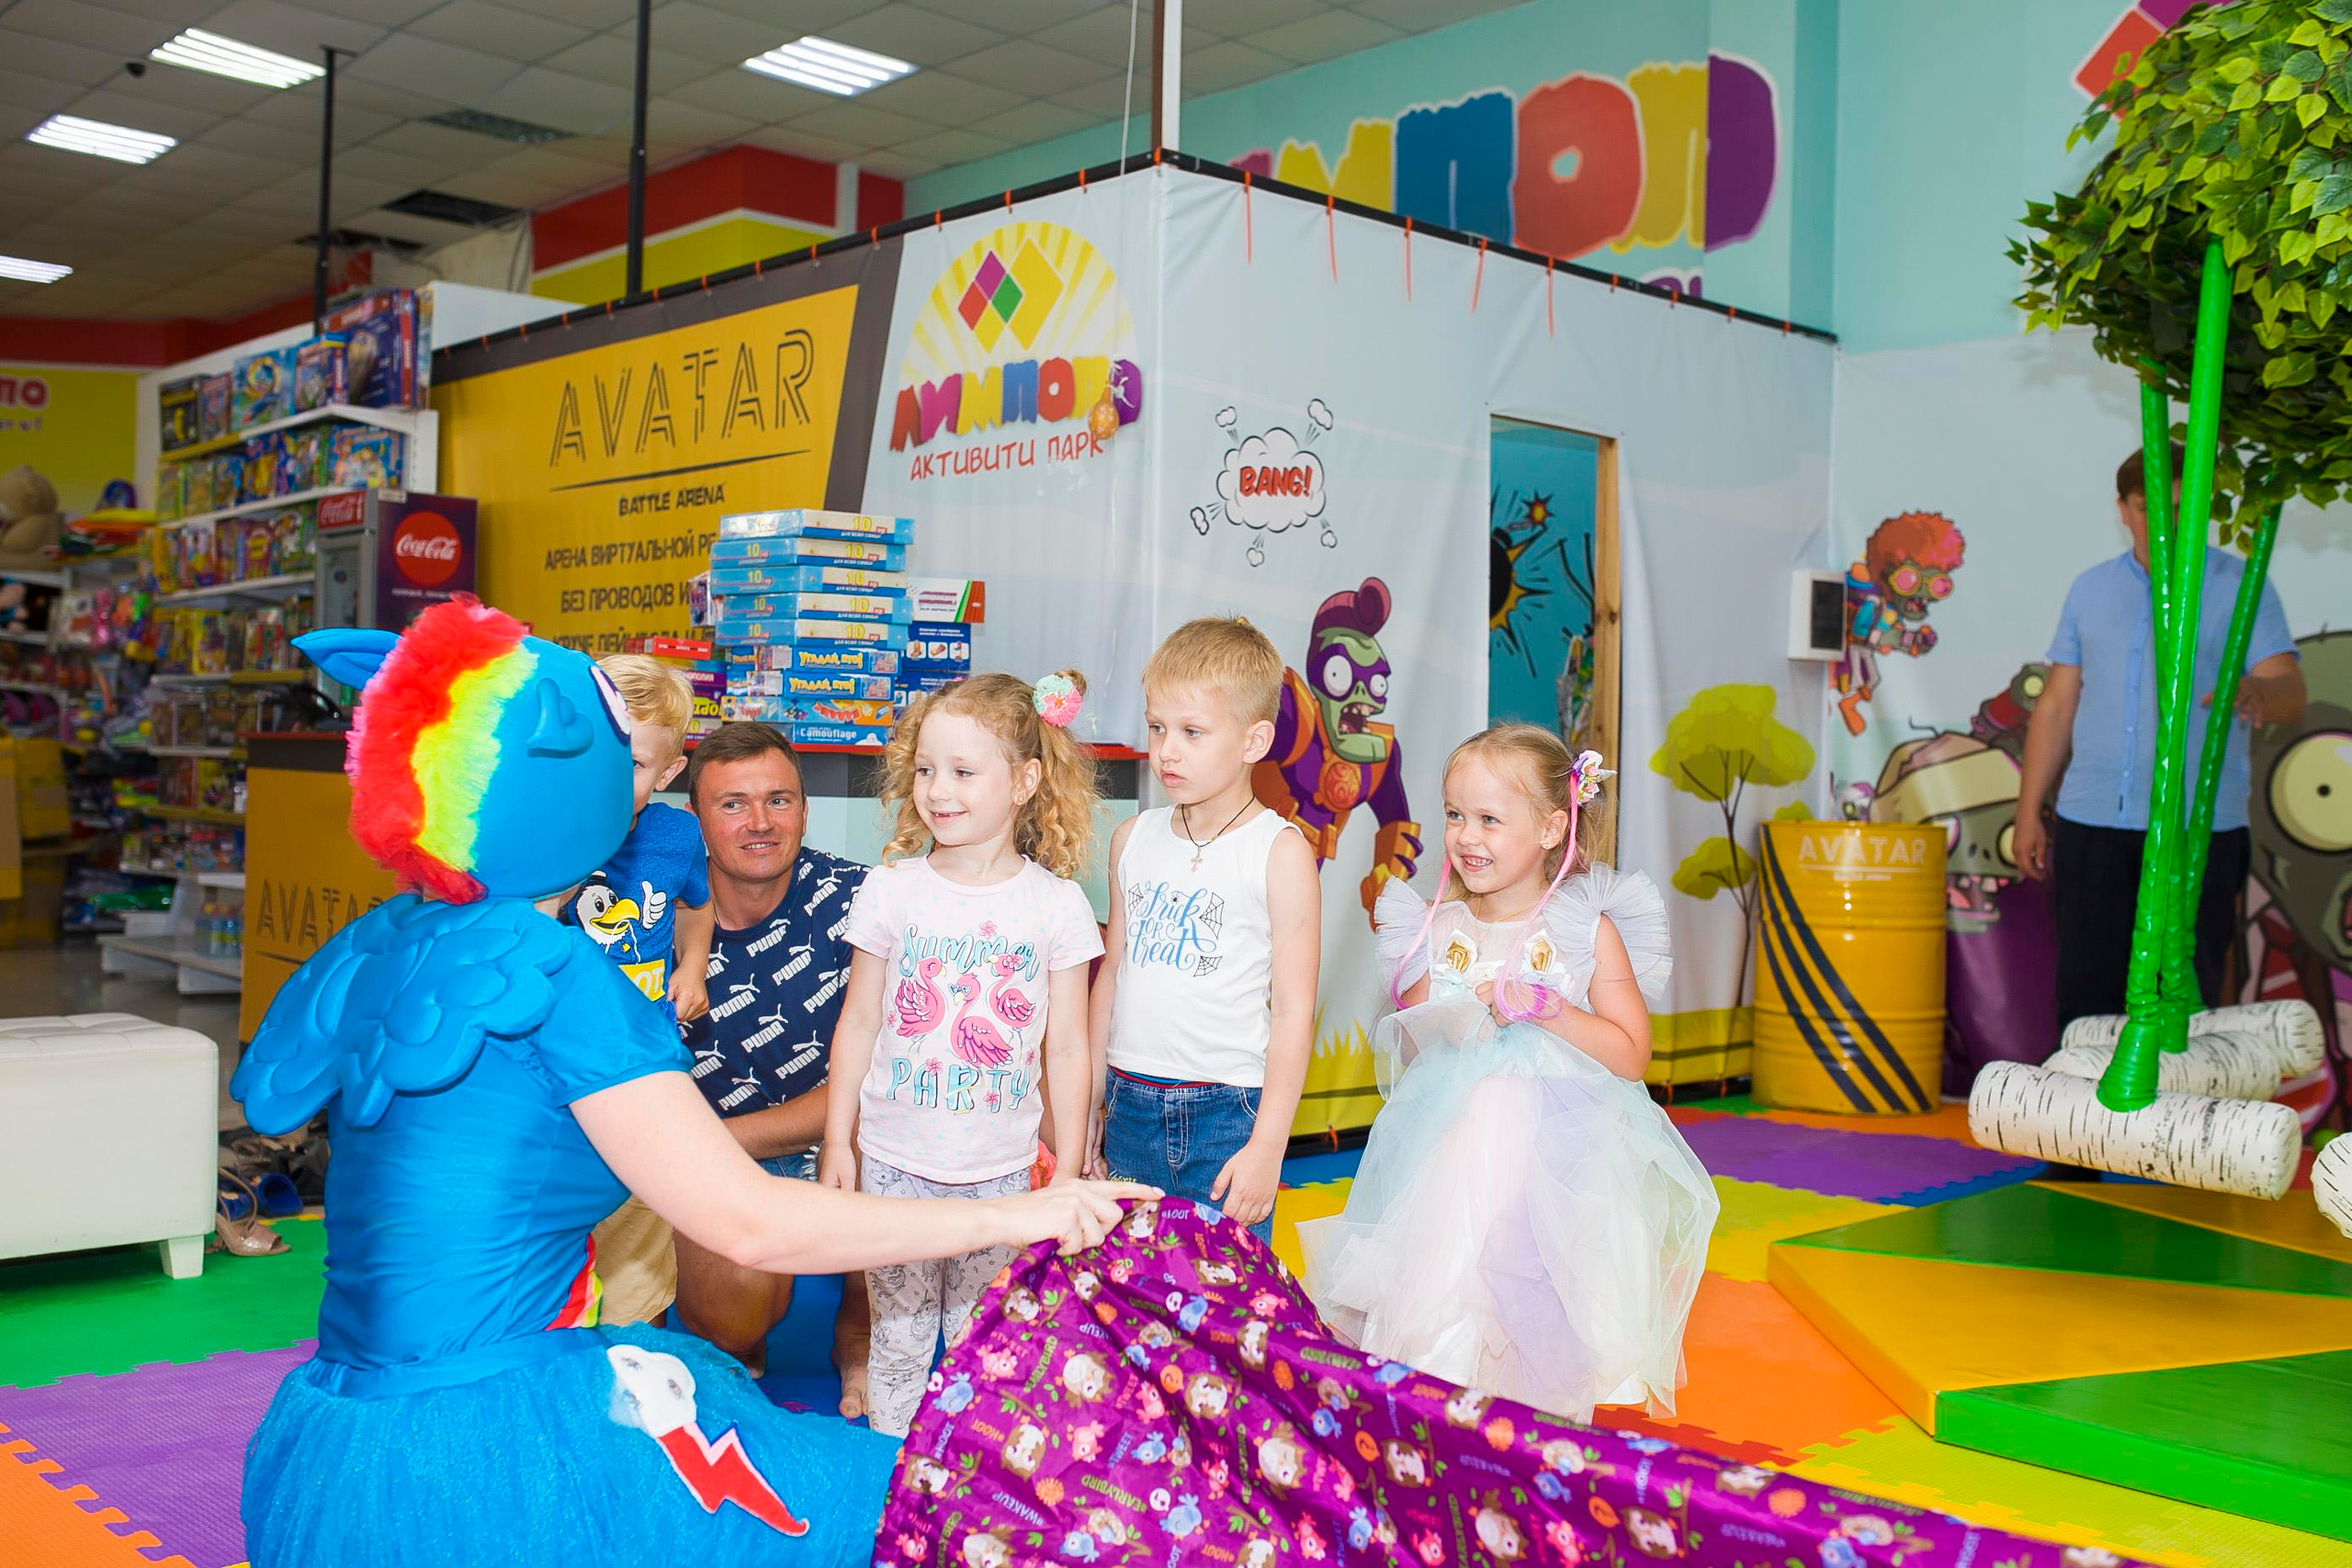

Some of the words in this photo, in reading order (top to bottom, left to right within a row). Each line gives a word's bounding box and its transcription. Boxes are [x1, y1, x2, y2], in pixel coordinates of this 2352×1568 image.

[548, 329, 814, 468] AVATAR
[910, 439, 1035, 481] АКТИВИТИ
[1047, 432, 1104, 463] ПАРК
[1239, 466, 1313, 498] BANG!
[618, 490, 671, 517] BATTLE
[674, 483, 726, 508] ARENA
[853, 517, 873, 532] 10
[544, 545, 587, 570] АРЕНА
[591, 529, 695, 567] ВИРТУАЛЬНОЙ
[747, 544, 761, 558] 10
[845, 544, 865, 558] 10
[748, 570, 763, 583] 10
[846, 571, 865, 586] 10
[560, 590, 585, 613] БЕЗ
[589, 582, 675, 613] ПРОВОДОВ
[679, 581, 690, 605] И
[753, 598, 766, 612] 10
[850, 598, 870, 613] 10
[748, 624, 762, 637] 10
[845, 624, 865, 638] 10
[800, 728, 858, 740] Camouflage
[1797, 835, 1927, 865] AVATAR
[256, 879, 384, 950] AVAT
[827, 916, 850, 942] PU
[1128, 919, 1196, 971] treat
[772, 951, 812, 987] PUMA
[709, 990, 756, 1022] PUMA
[741, 1021, 786, 1054] PUMA
[690, 1056, 723, 1079] UMA
[775, 1047, 821, 1080] PUMA
[718, 1084, 760, 1111] PUMA
[886, 1057, 1032, 1114] PARTY
[991, 1492, 1045, 1526] #WAKEUP
[1081, 1474, 1148, 1513] #EARLYBIRD
